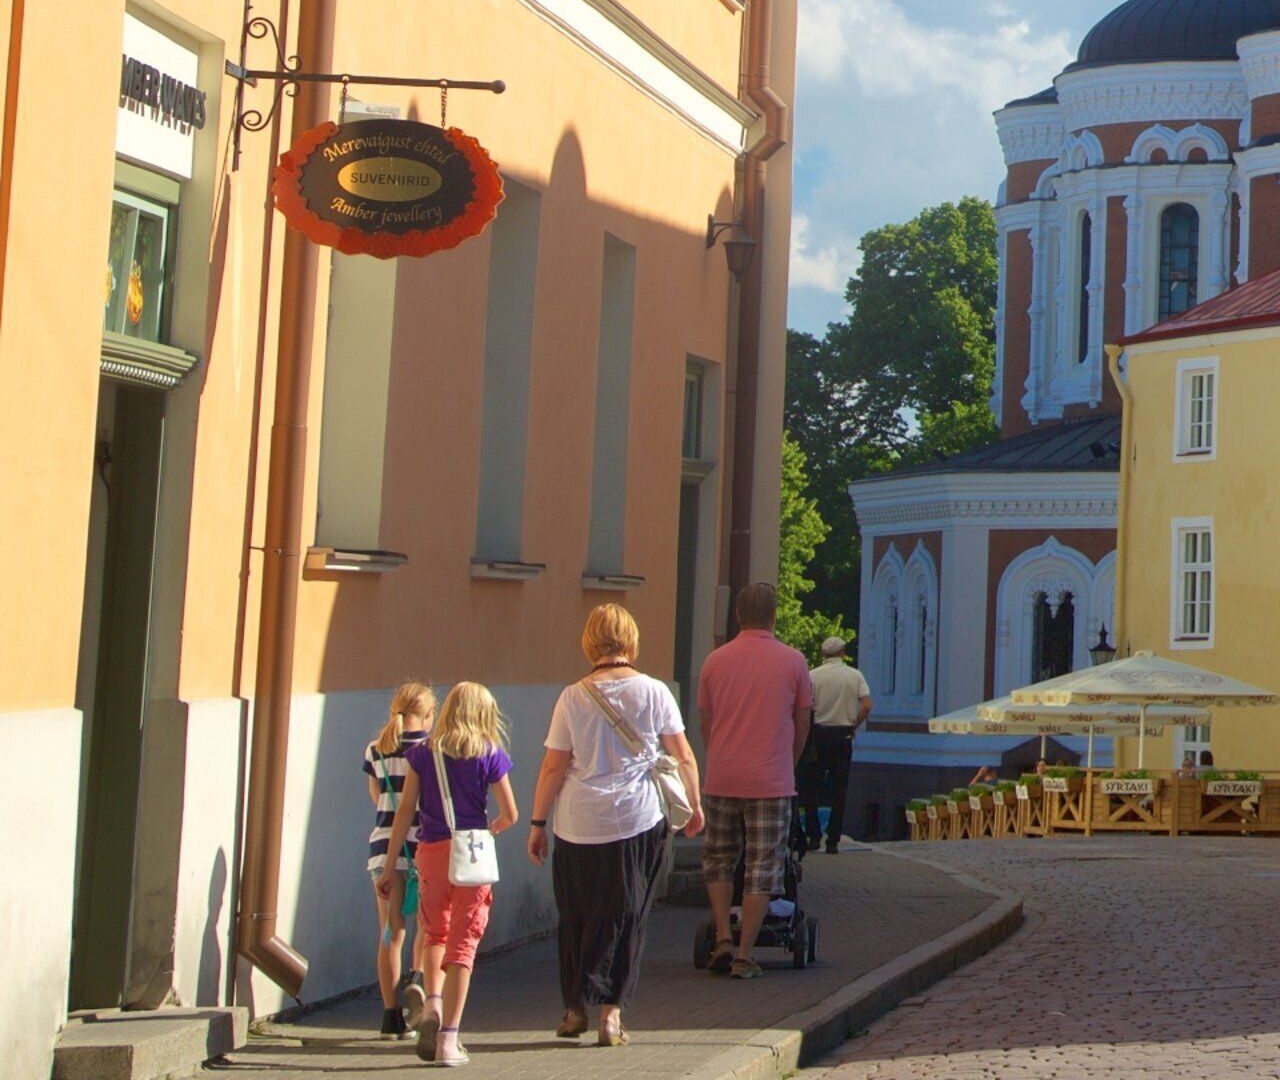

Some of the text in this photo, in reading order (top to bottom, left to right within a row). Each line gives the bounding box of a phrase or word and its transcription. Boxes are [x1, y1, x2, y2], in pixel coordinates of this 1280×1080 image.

[323, 132, 454, 165] Merevaigust ehted
[350, 172, 431, 186] SUVENIIRID
[330, 197, 442, 228] Amber jewellery
[1105, 782, 1148, 792] SYRTAKI
[1213, 783, 1256, 793] SYRTAKI
